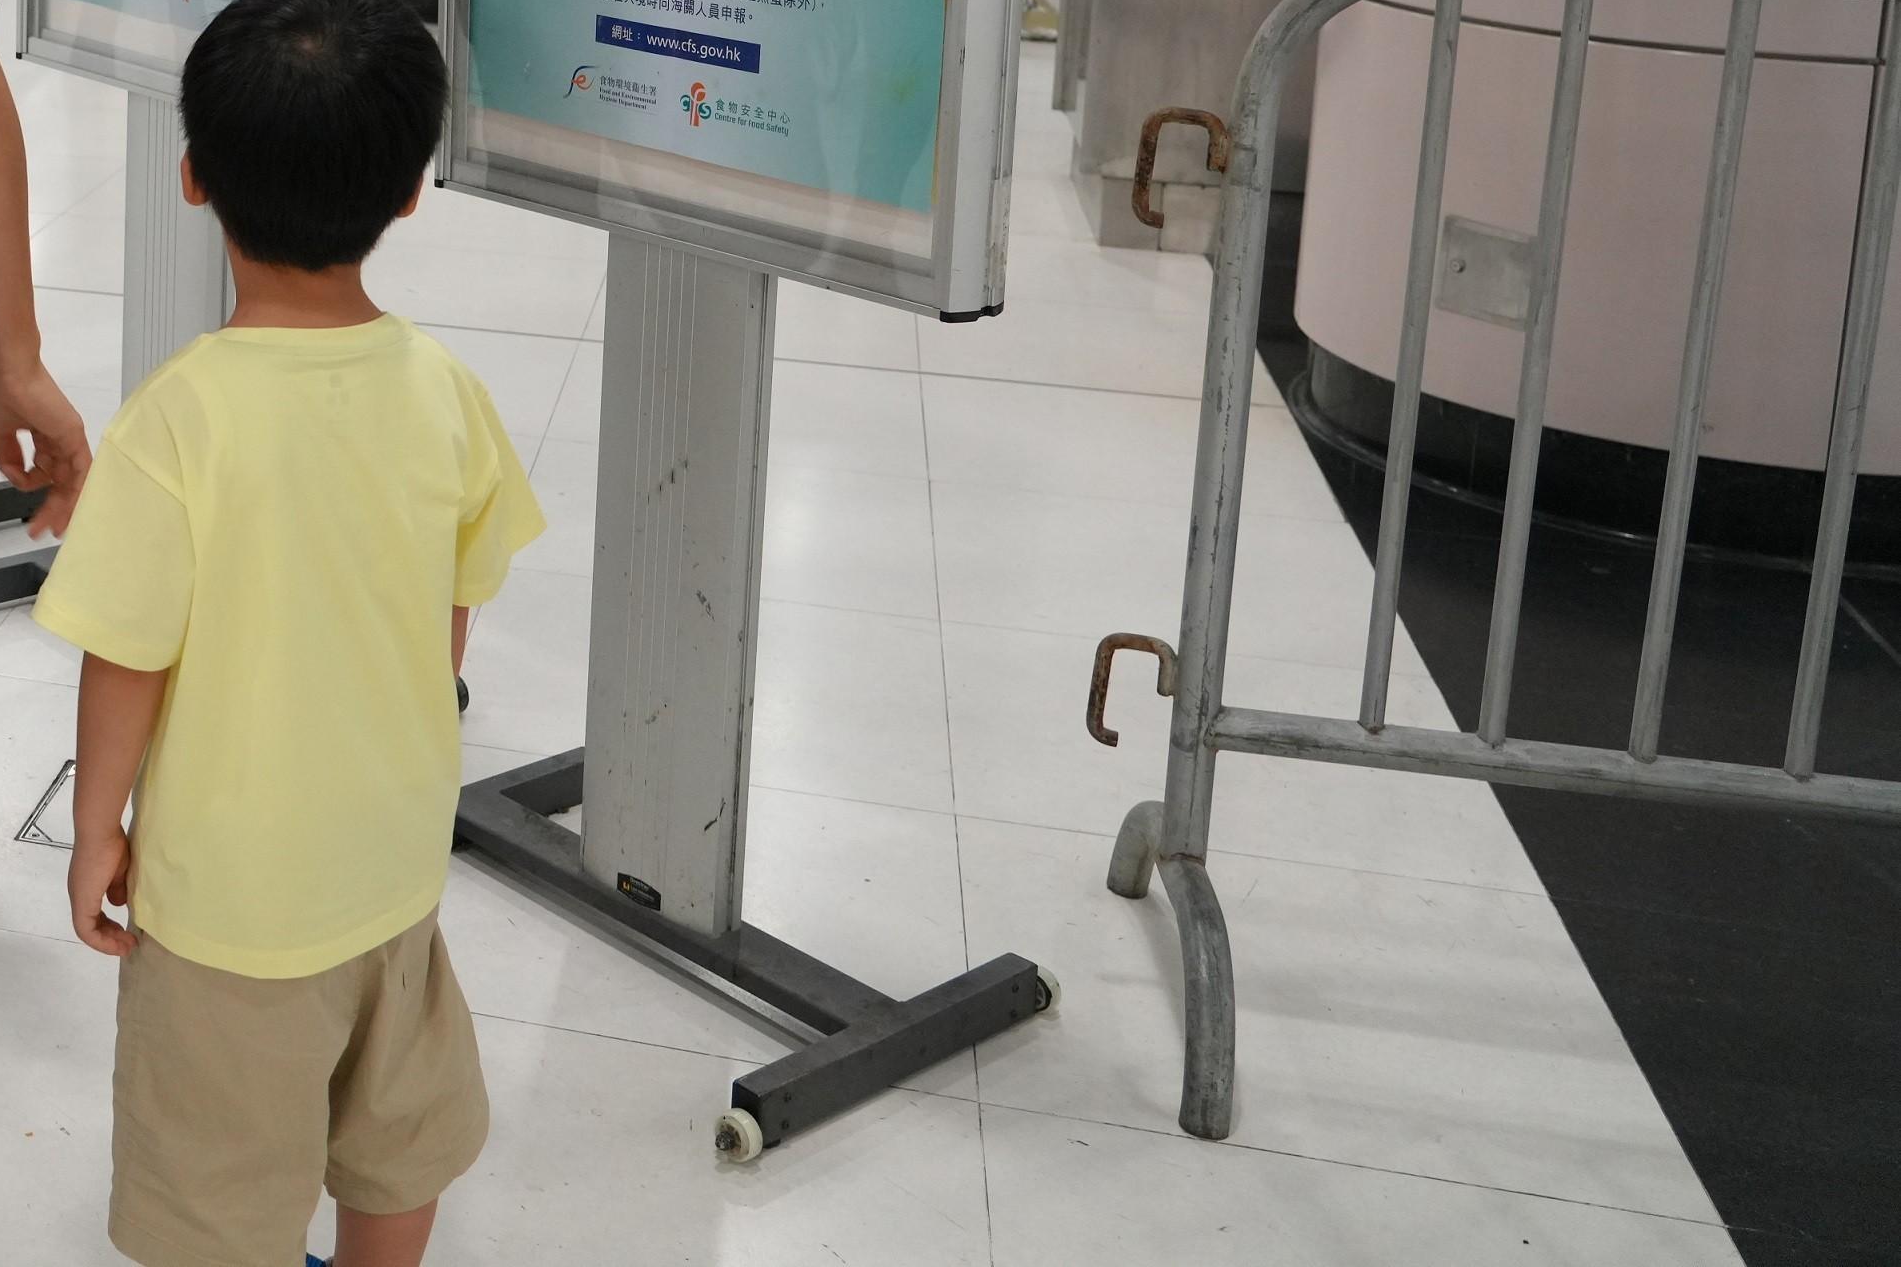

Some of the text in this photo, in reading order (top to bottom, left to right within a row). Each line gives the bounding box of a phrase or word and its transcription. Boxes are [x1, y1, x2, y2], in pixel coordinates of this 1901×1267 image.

[647, 34, 741, 62] www.cfs.gov.hk
[714, 112, 736, 125] Centre
[737, 116, 748, 126] for
[766, 122, 789, 138] Safety
[715, 98, 791, 125] 食物安全中心
